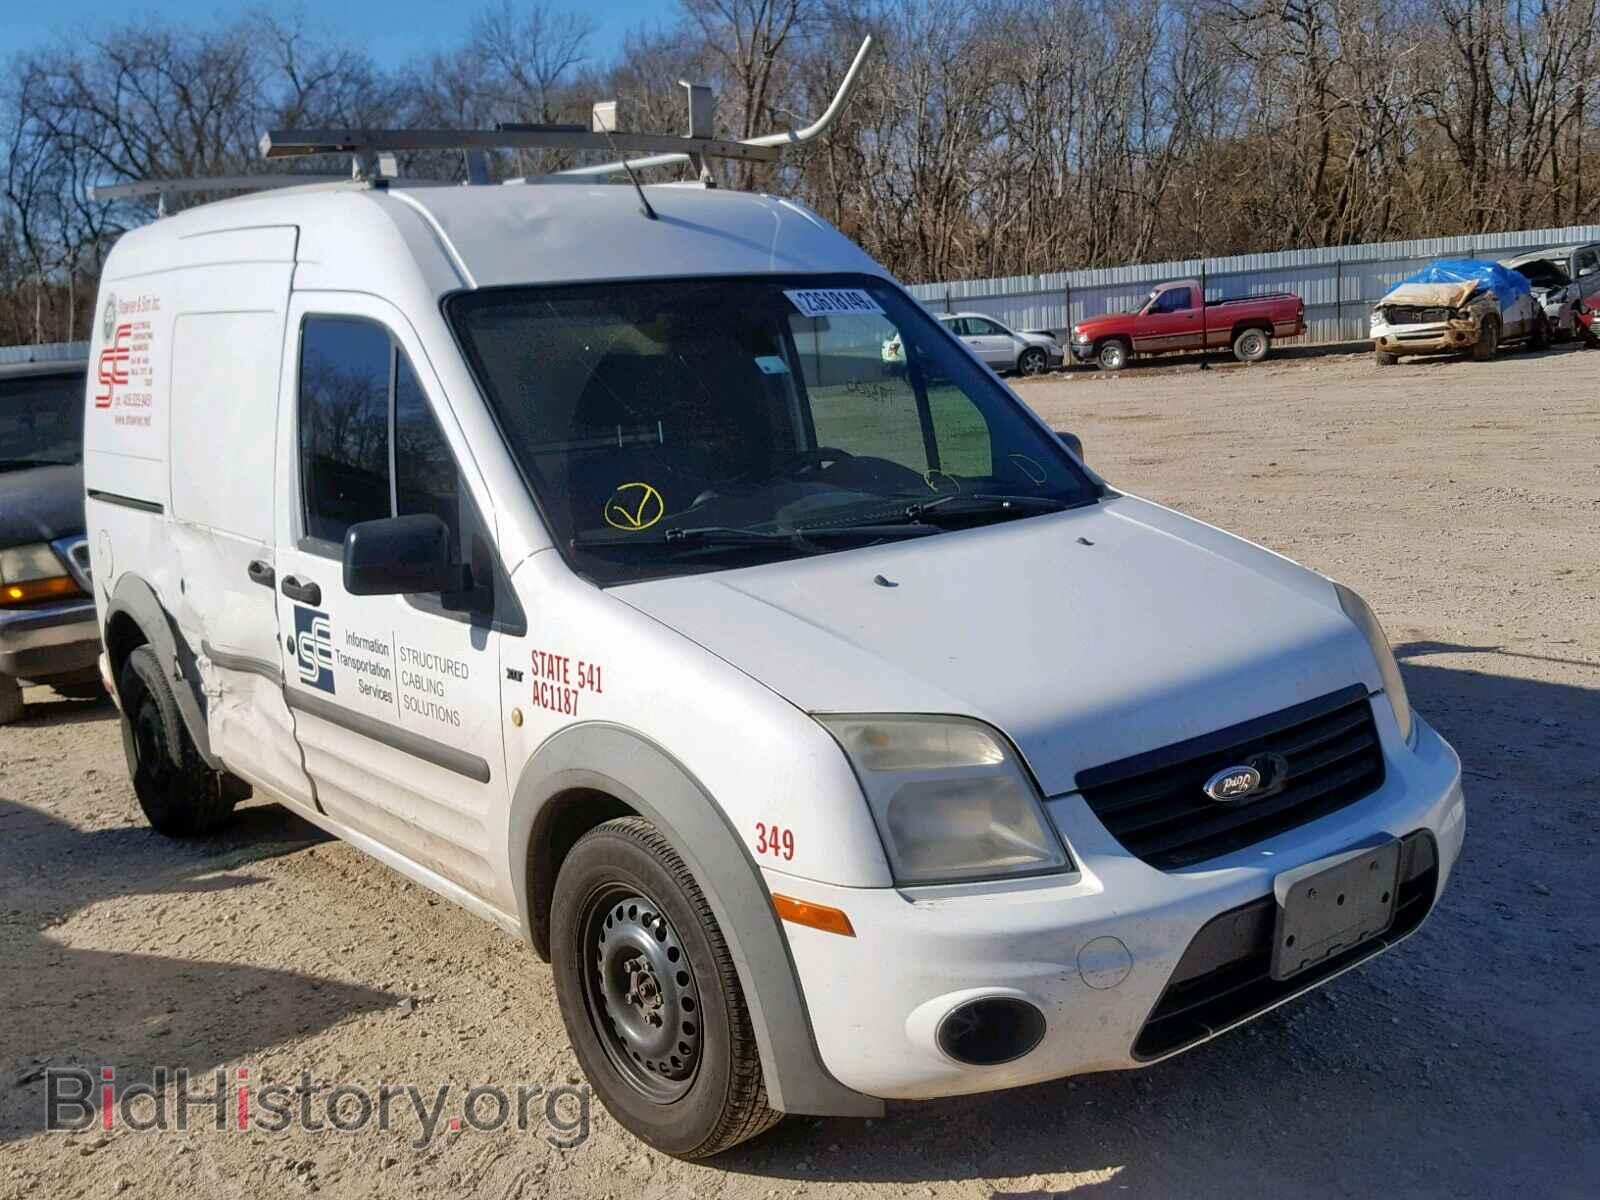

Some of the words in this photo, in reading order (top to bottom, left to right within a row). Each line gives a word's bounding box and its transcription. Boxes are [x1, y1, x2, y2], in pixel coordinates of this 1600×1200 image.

[345, 629, 389, 656] Information
[336, 649, 391, 680] Transportation
[400, 647, 468, 679] STRUCTURED
[532, 650, 570, 684] STATE
[578, 661, 602, 693] 541
[358, 679, 392, 703] Services
[402, 672, 444, 696] CABLING
[533, 680, 578, 716] AC1187
[403, 694, 460, 726] SOLUTIONS
[756, 822, 794, 860] 349
